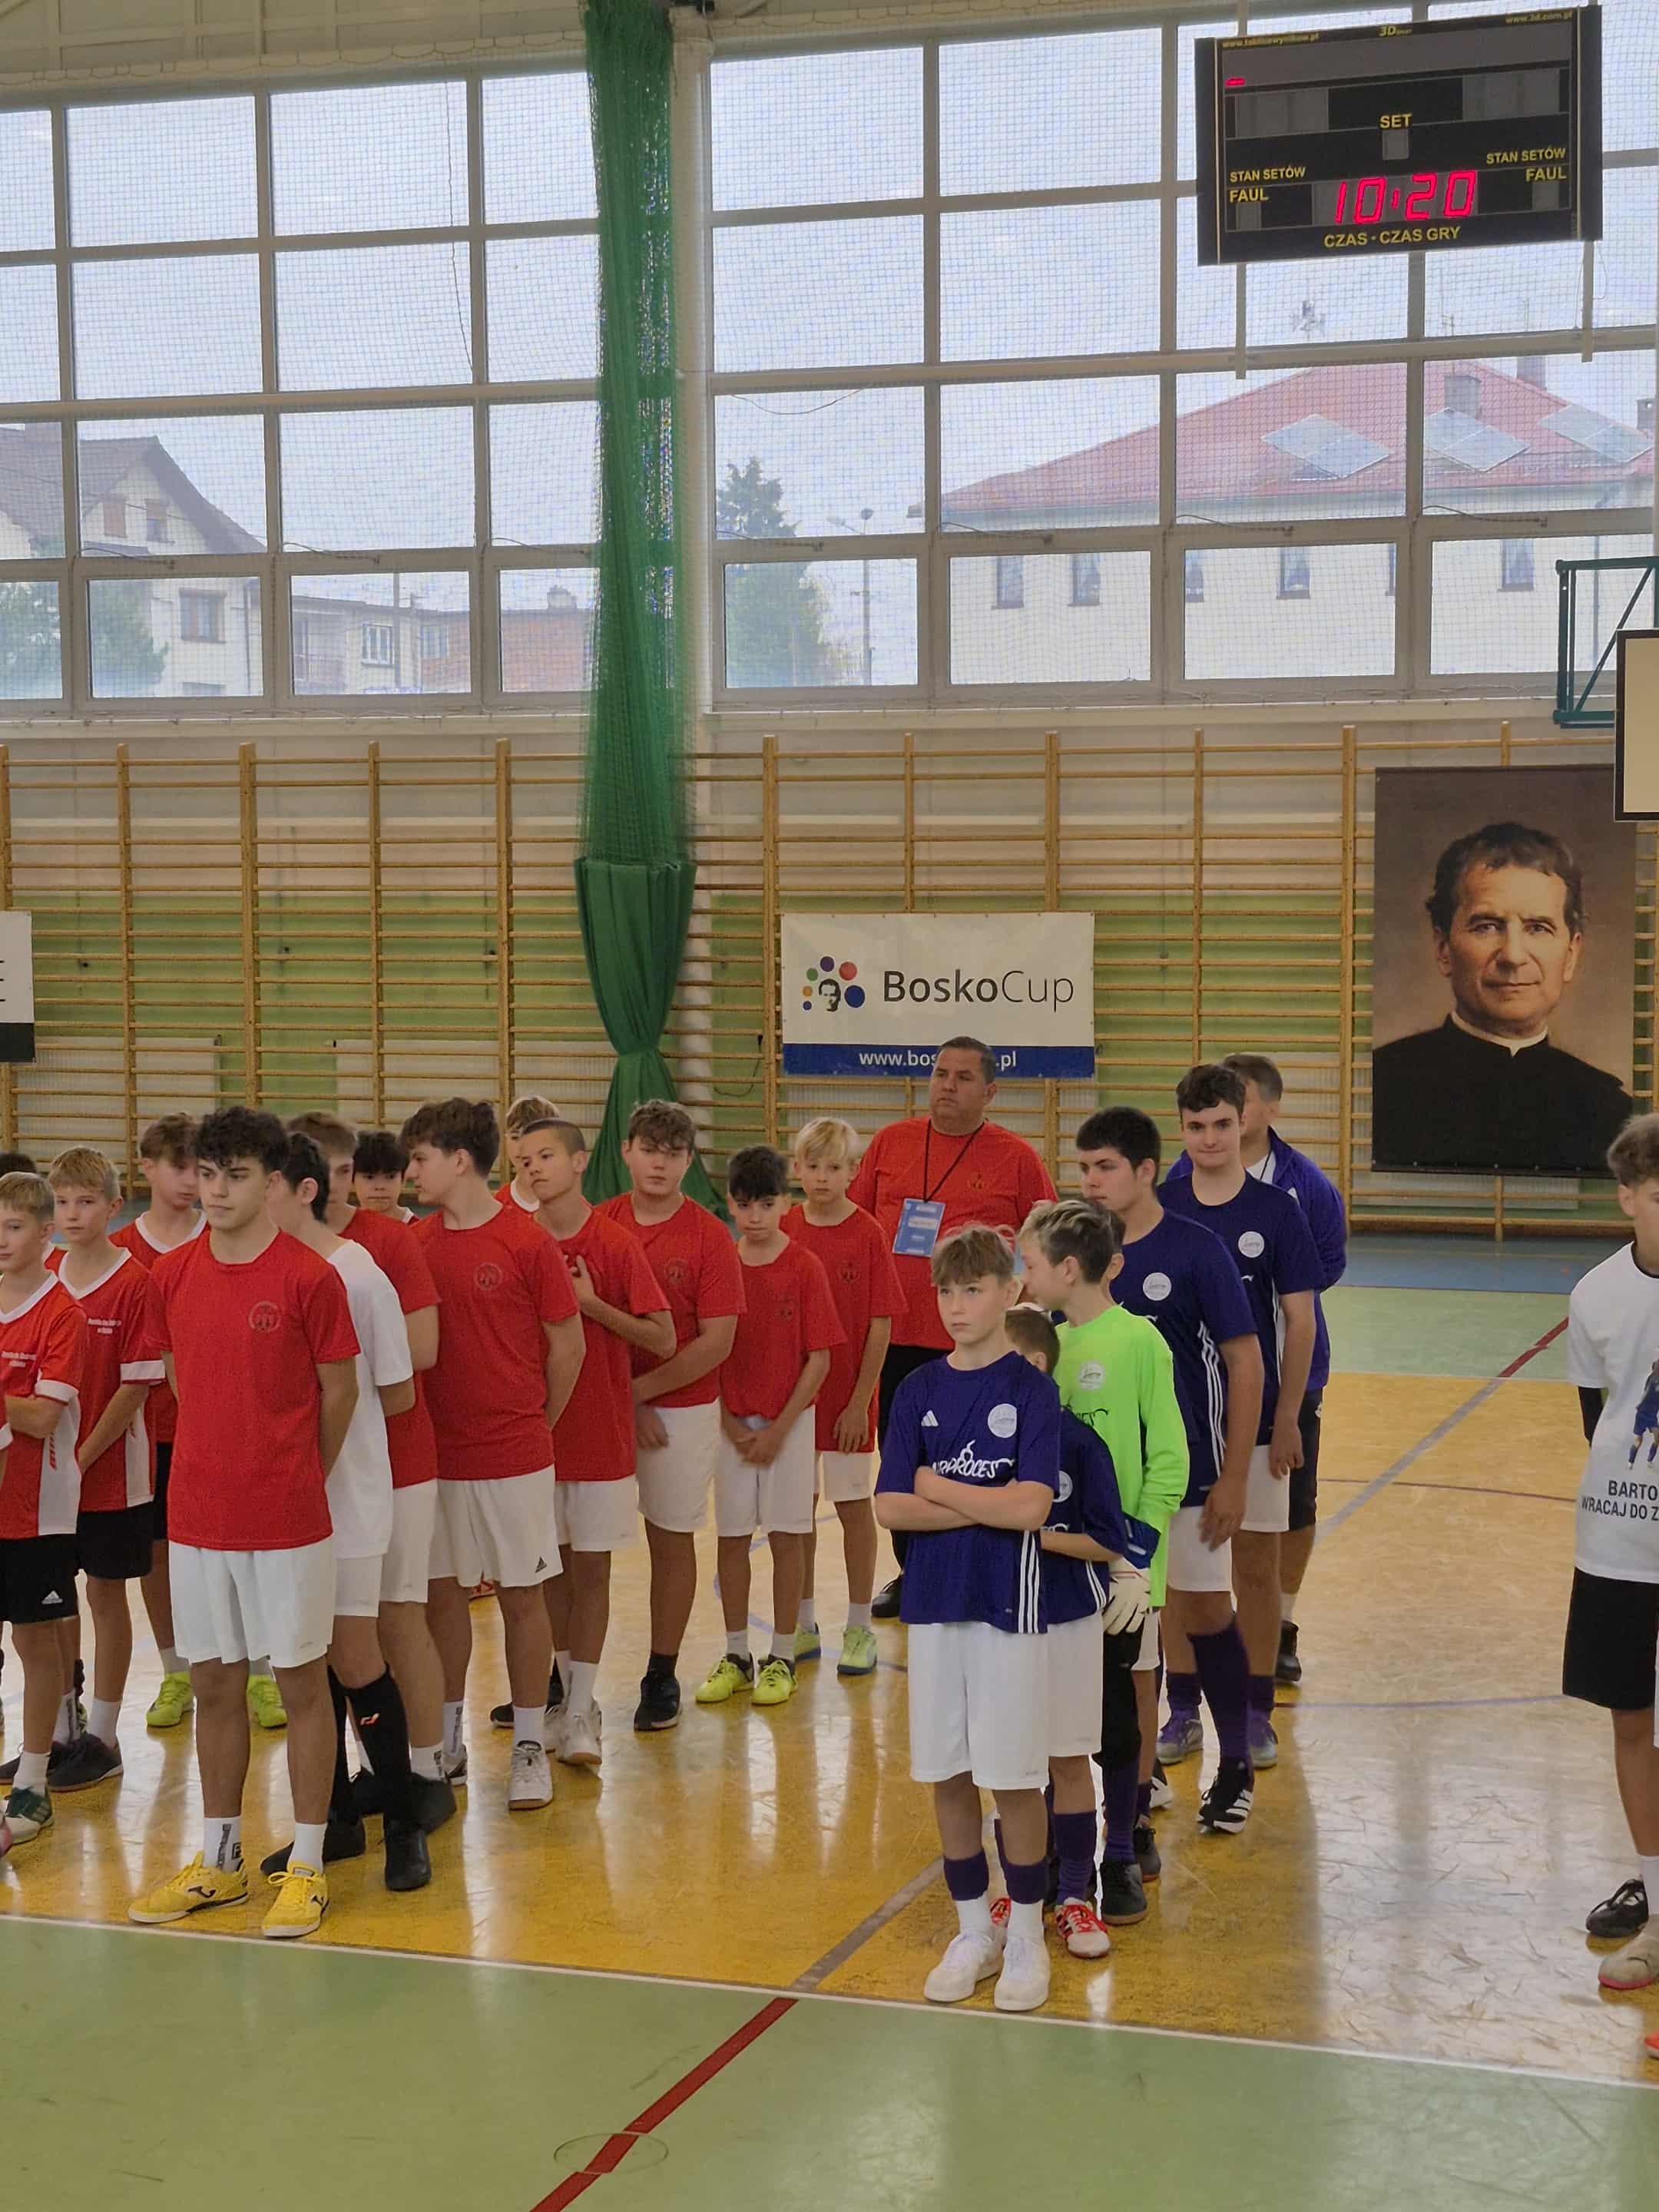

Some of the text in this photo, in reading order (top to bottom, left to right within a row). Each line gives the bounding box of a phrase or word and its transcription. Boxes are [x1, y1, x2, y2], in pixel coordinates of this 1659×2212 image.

[1379, 113, 1412, 129] SET
[1486, 144, 1566, 164] STAN SETÓW
[1230, 164, 1306, 183] STAN SETÓW
[1525, 166, 1567, 182] FAUL
[1229, 187, 1269, 204] FAUL
[1323, 232, 1368, 248] CZAS
[1379, 228, 1422, 244] CZAS
[1426, 226, 1461, 241] GRY
[883, 969, 1074, 1012] BoskoCup
[1630, 1503, 1647, 1520] DO
